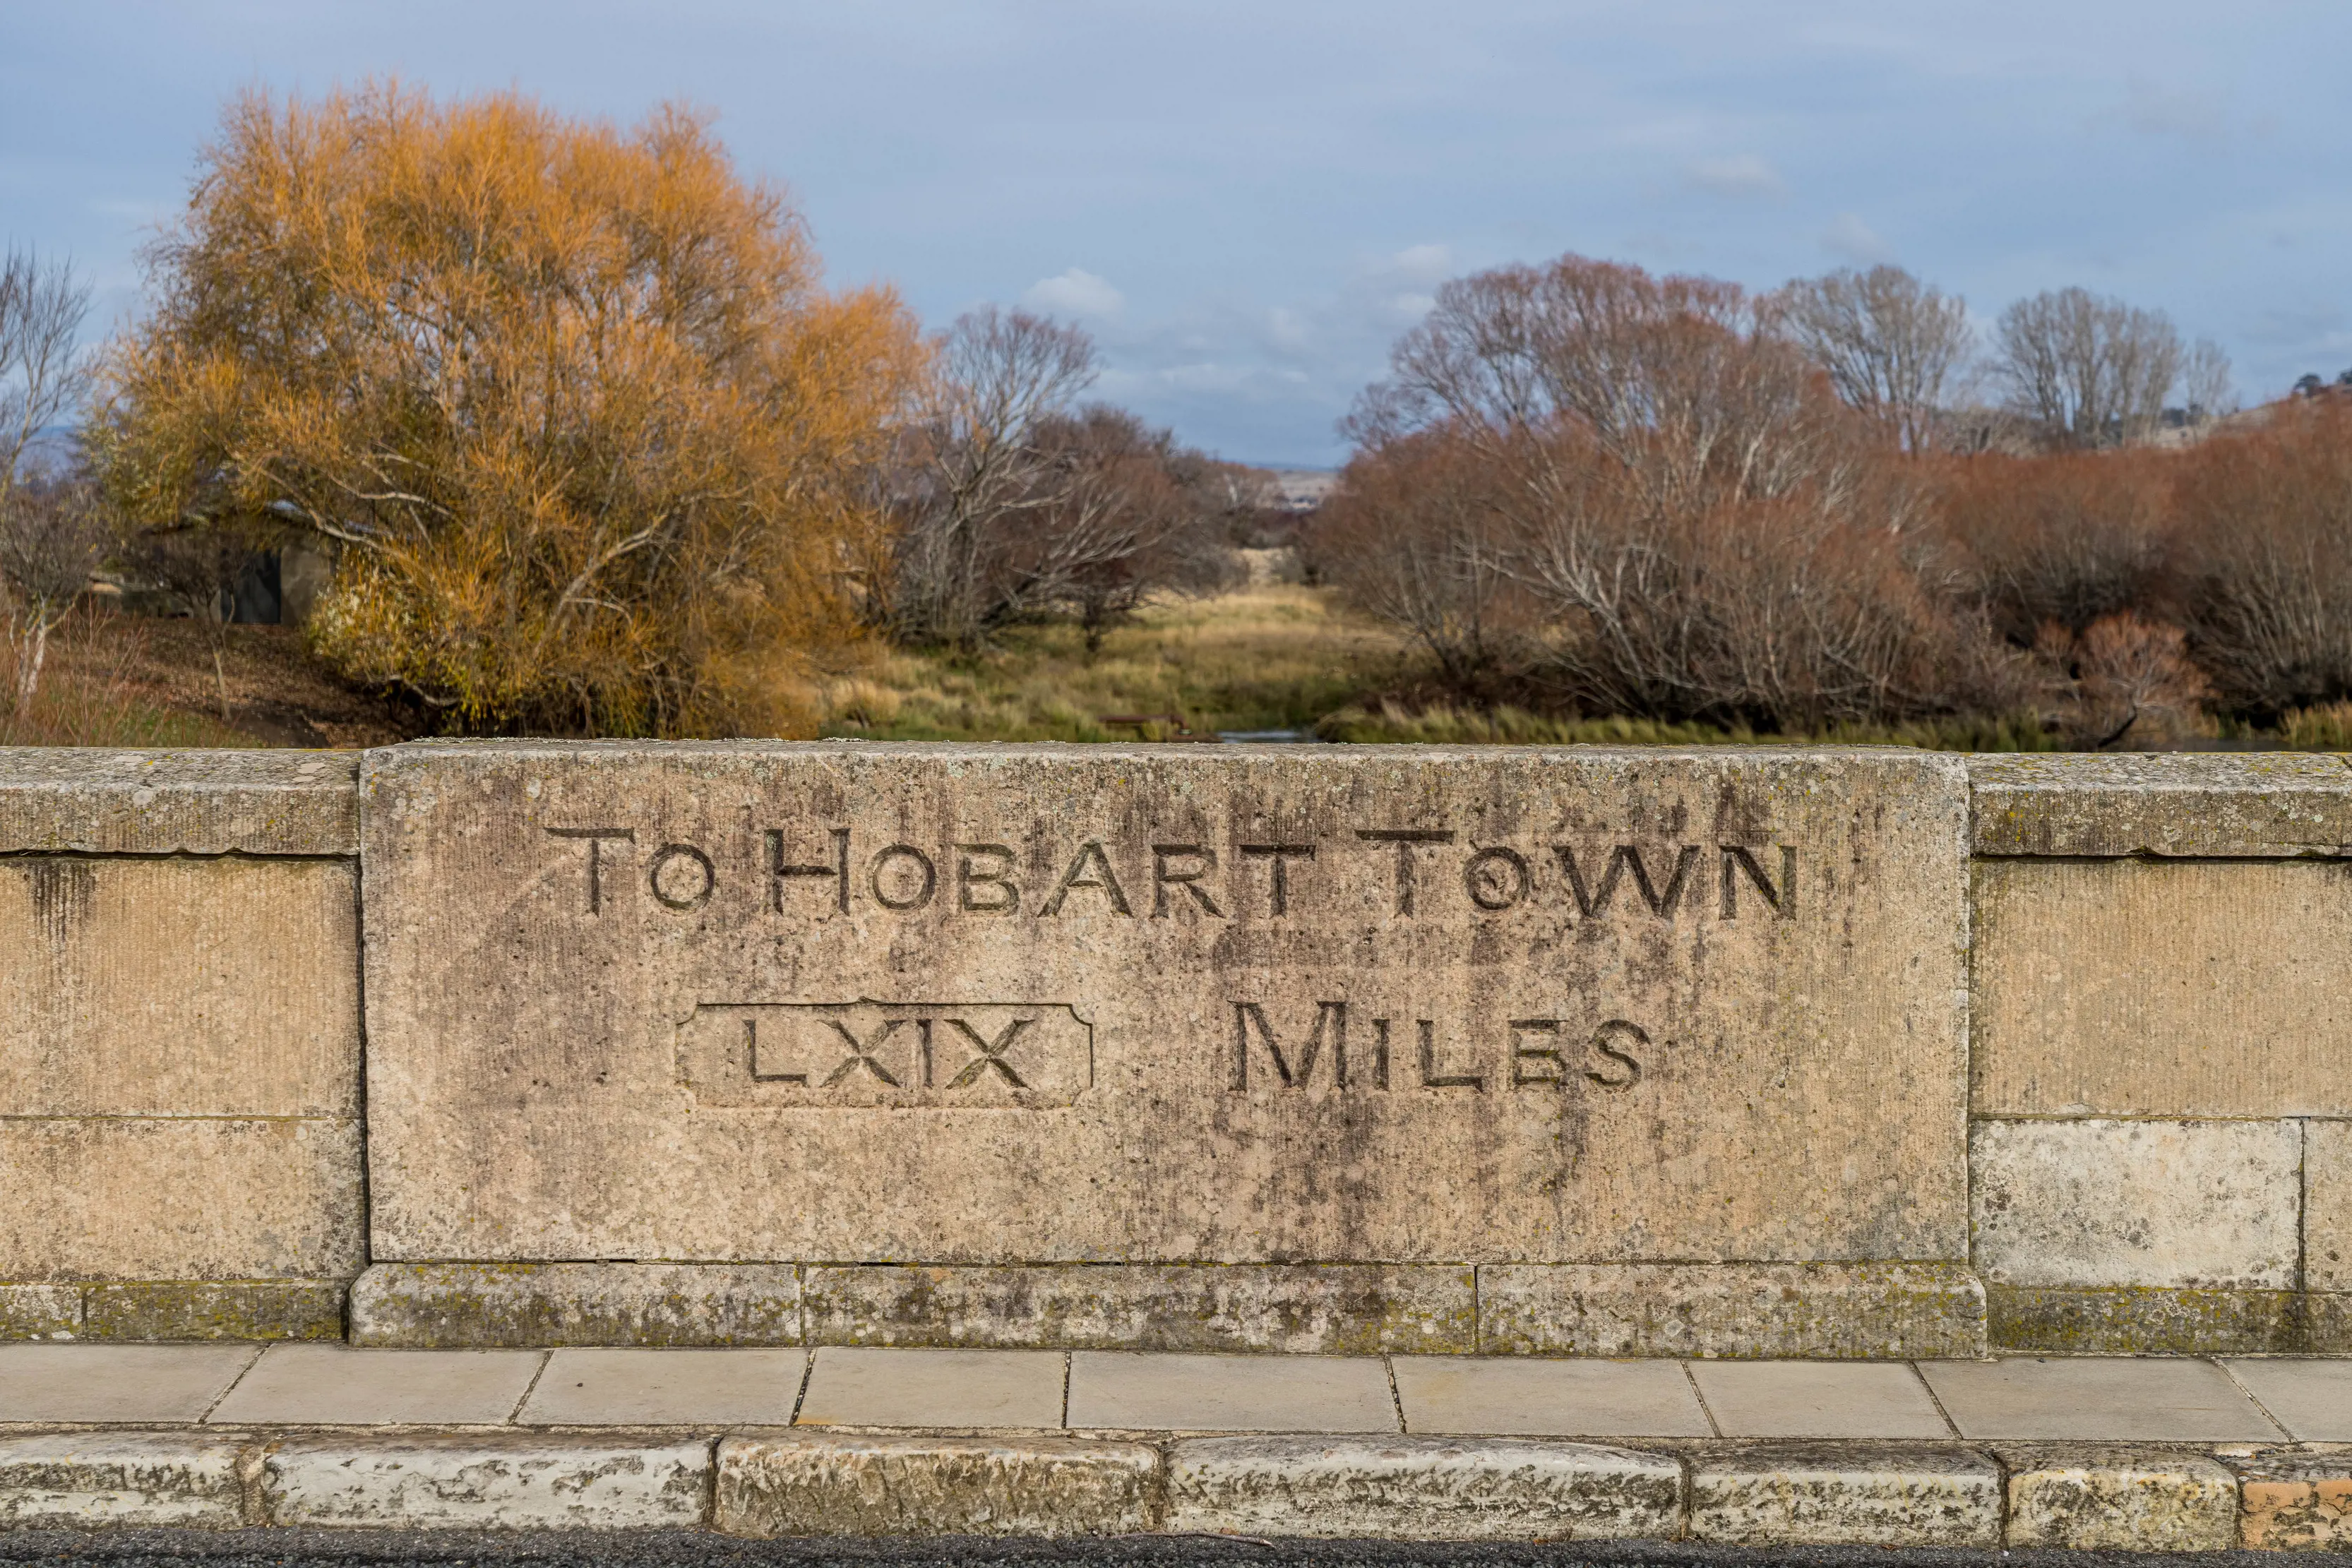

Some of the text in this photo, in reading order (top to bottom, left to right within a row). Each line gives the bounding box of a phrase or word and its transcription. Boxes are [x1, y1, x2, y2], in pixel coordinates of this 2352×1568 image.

[544, 828, 1796, 919] TO HOBART TOWN
[742, 1000, 1650, 1093] LXIX MILES
